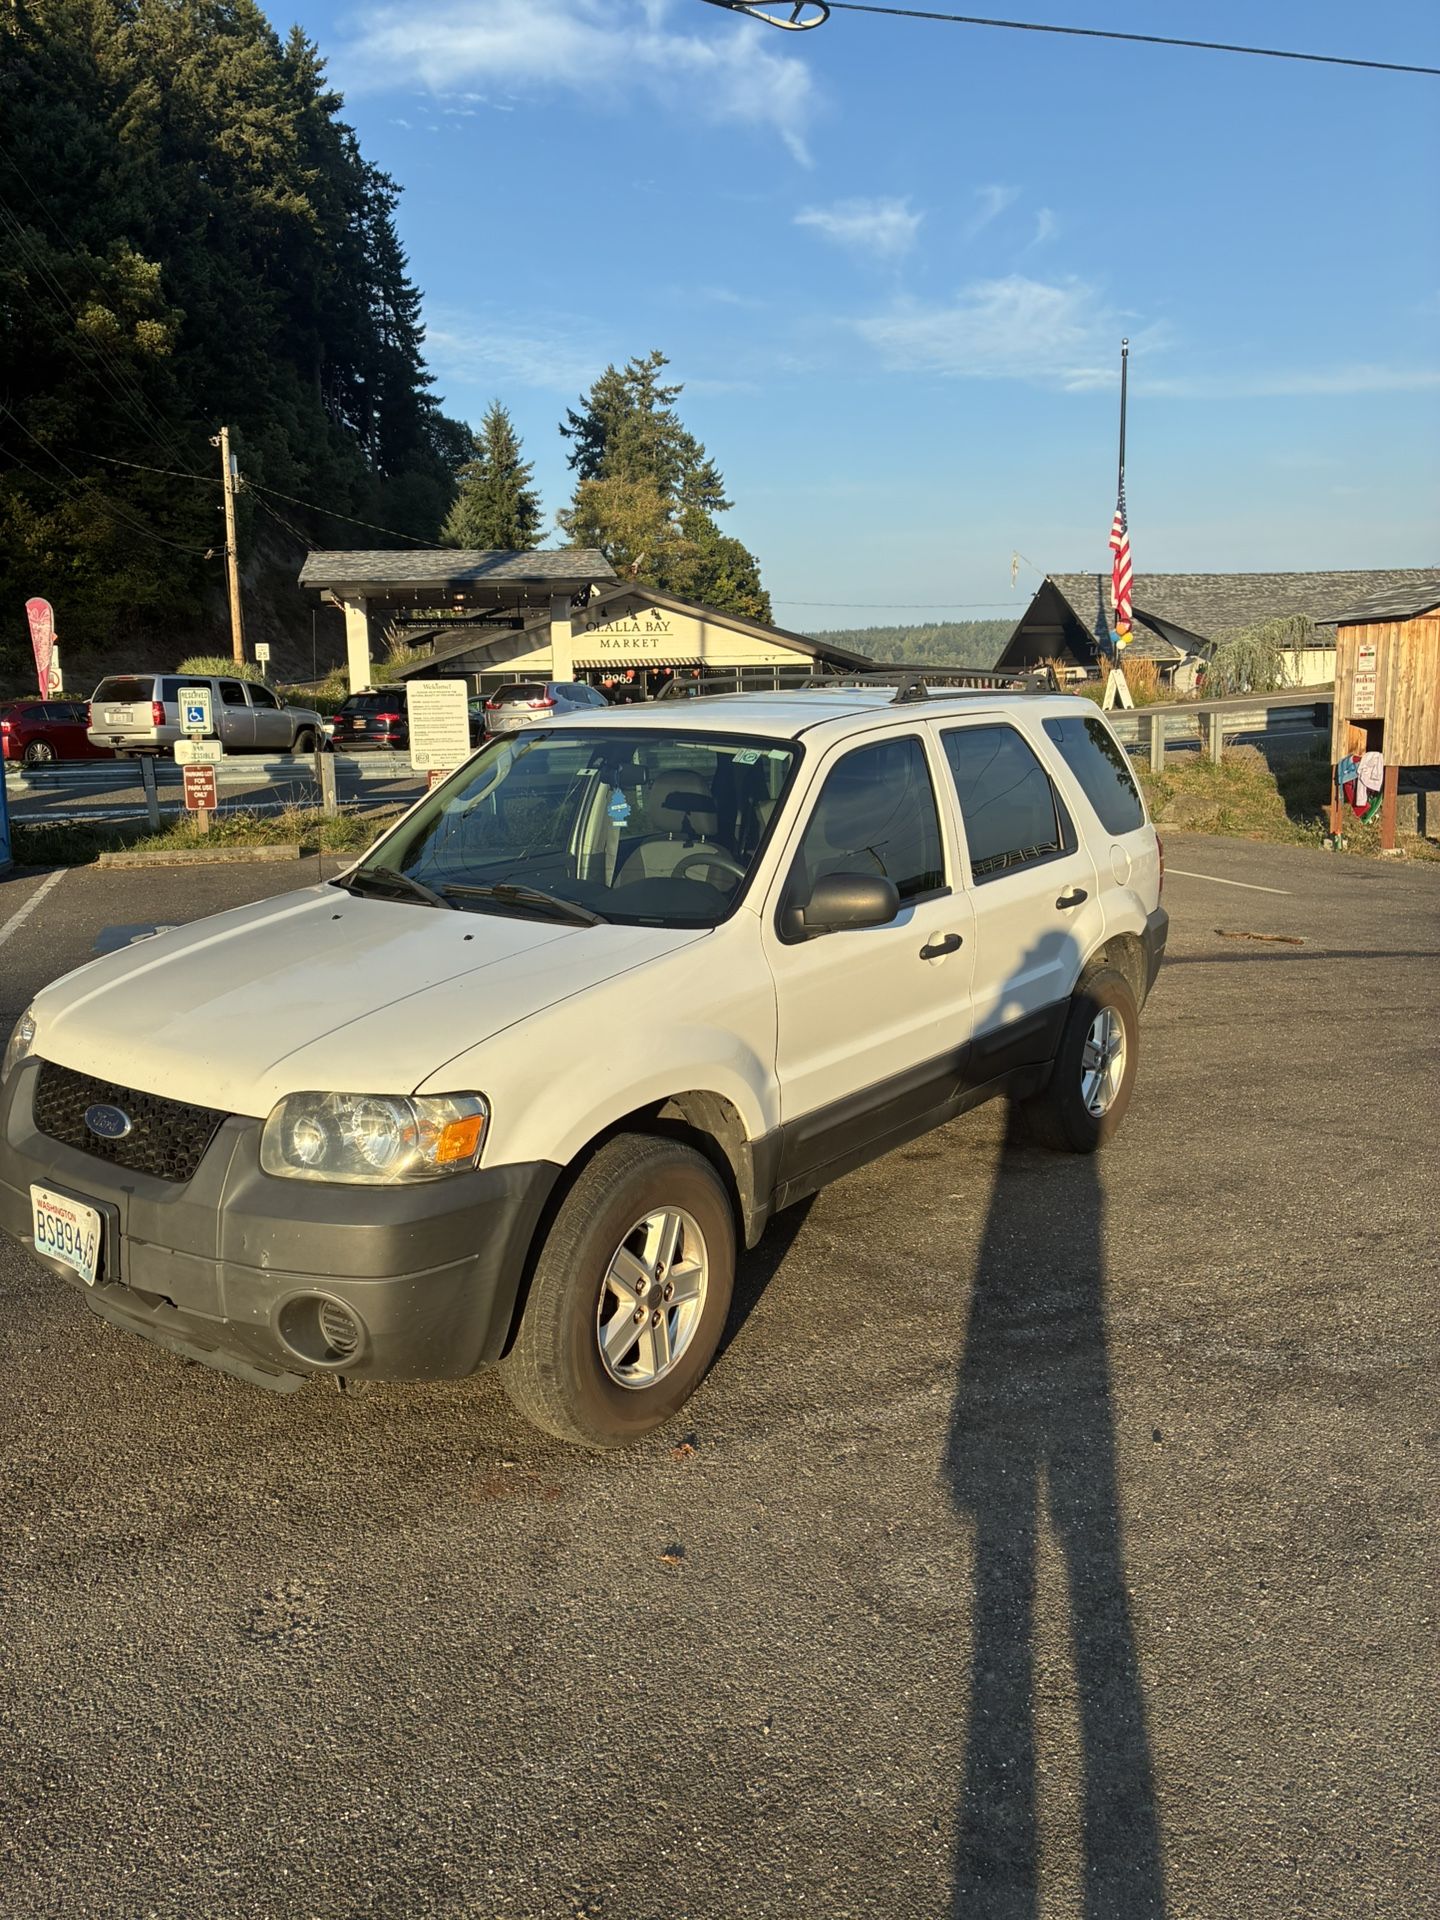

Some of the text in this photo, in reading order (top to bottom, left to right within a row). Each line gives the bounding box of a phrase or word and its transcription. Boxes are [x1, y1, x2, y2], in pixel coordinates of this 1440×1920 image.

[585, 621, 671, 632] OLALLA BAY
[600, 639, 659, 648] MARKET
[37, 1199, 77, 1223] WASHINGTON
